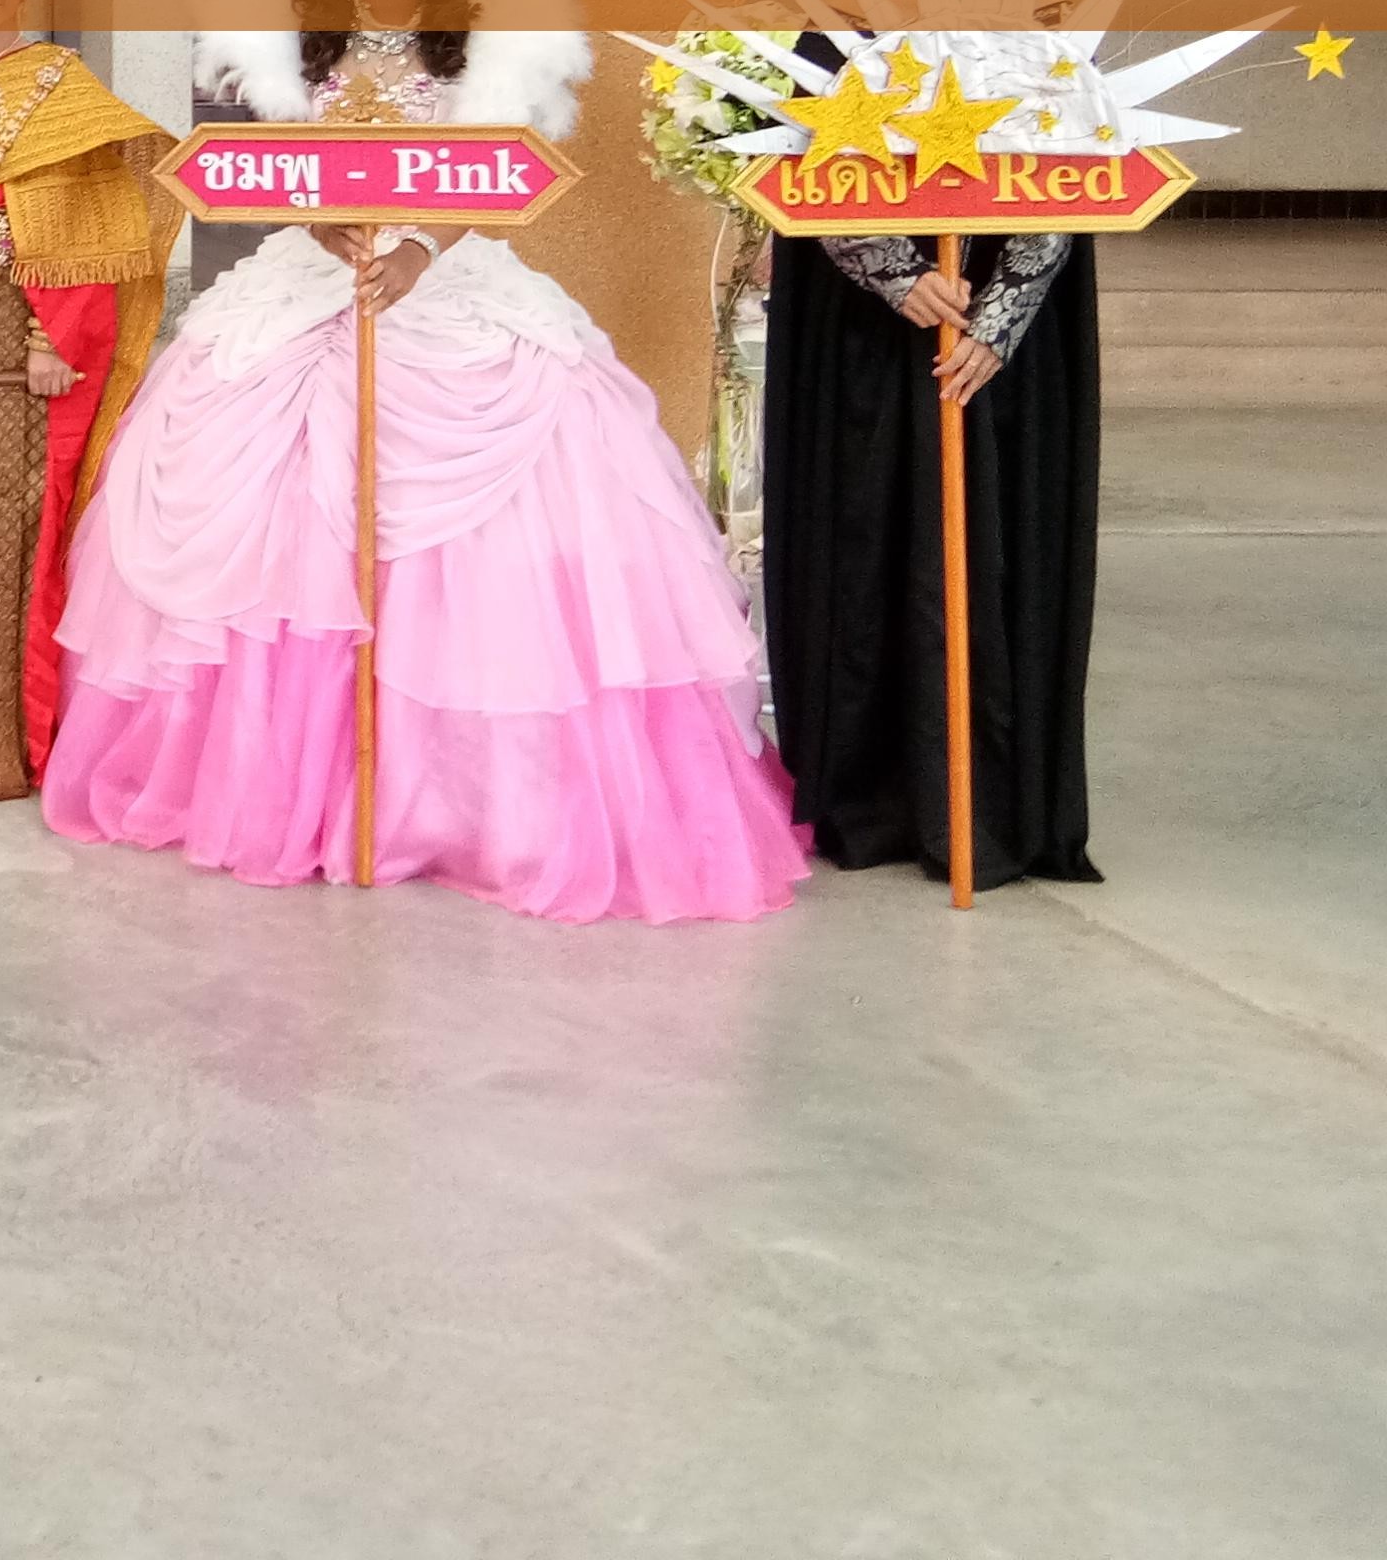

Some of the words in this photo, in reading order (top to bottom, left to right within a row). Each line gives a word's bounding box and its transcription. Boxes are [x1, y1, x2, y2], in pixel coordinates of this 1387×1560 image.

[196, 151, 322, 209] ชมพู
[392, 147, 532, 195] Pink
[779, 157, 908, 206] แดง
[993, 154, 1129, 203] Red
